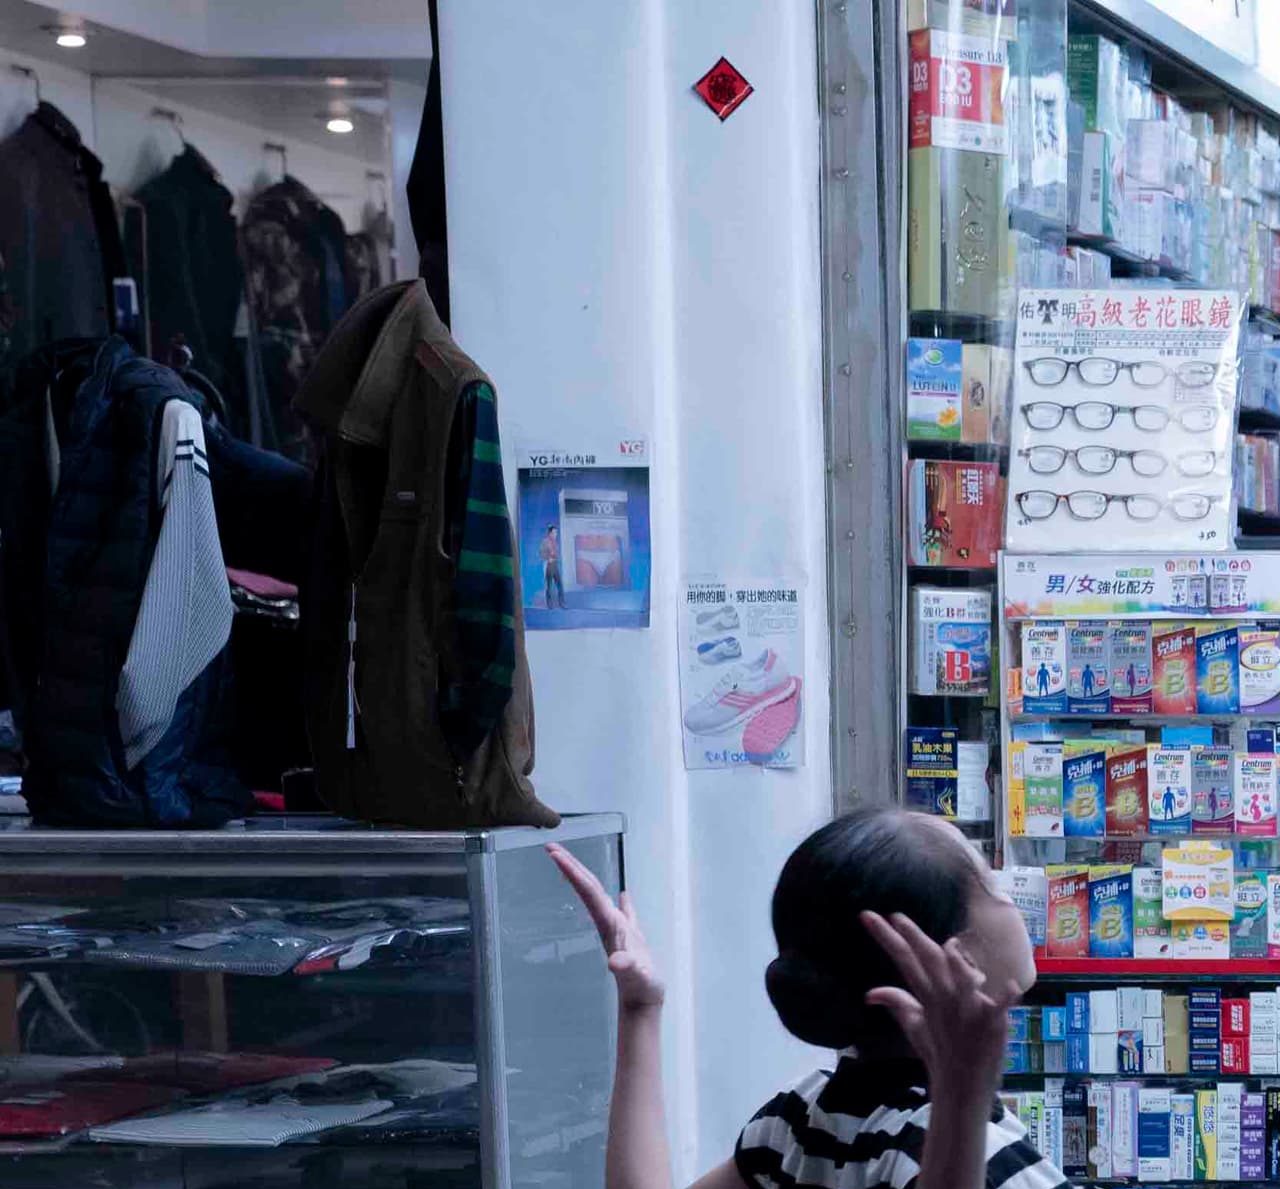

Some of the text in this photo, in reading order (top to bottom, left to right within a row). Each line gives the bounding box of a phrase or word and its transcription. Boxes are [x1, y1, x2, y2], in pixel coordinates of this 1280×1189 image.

[1075, 295, 1233, 329] 高級老花眼鏡
[529, 455, 548, 467] YG
[945, 651, 972, 682] B
